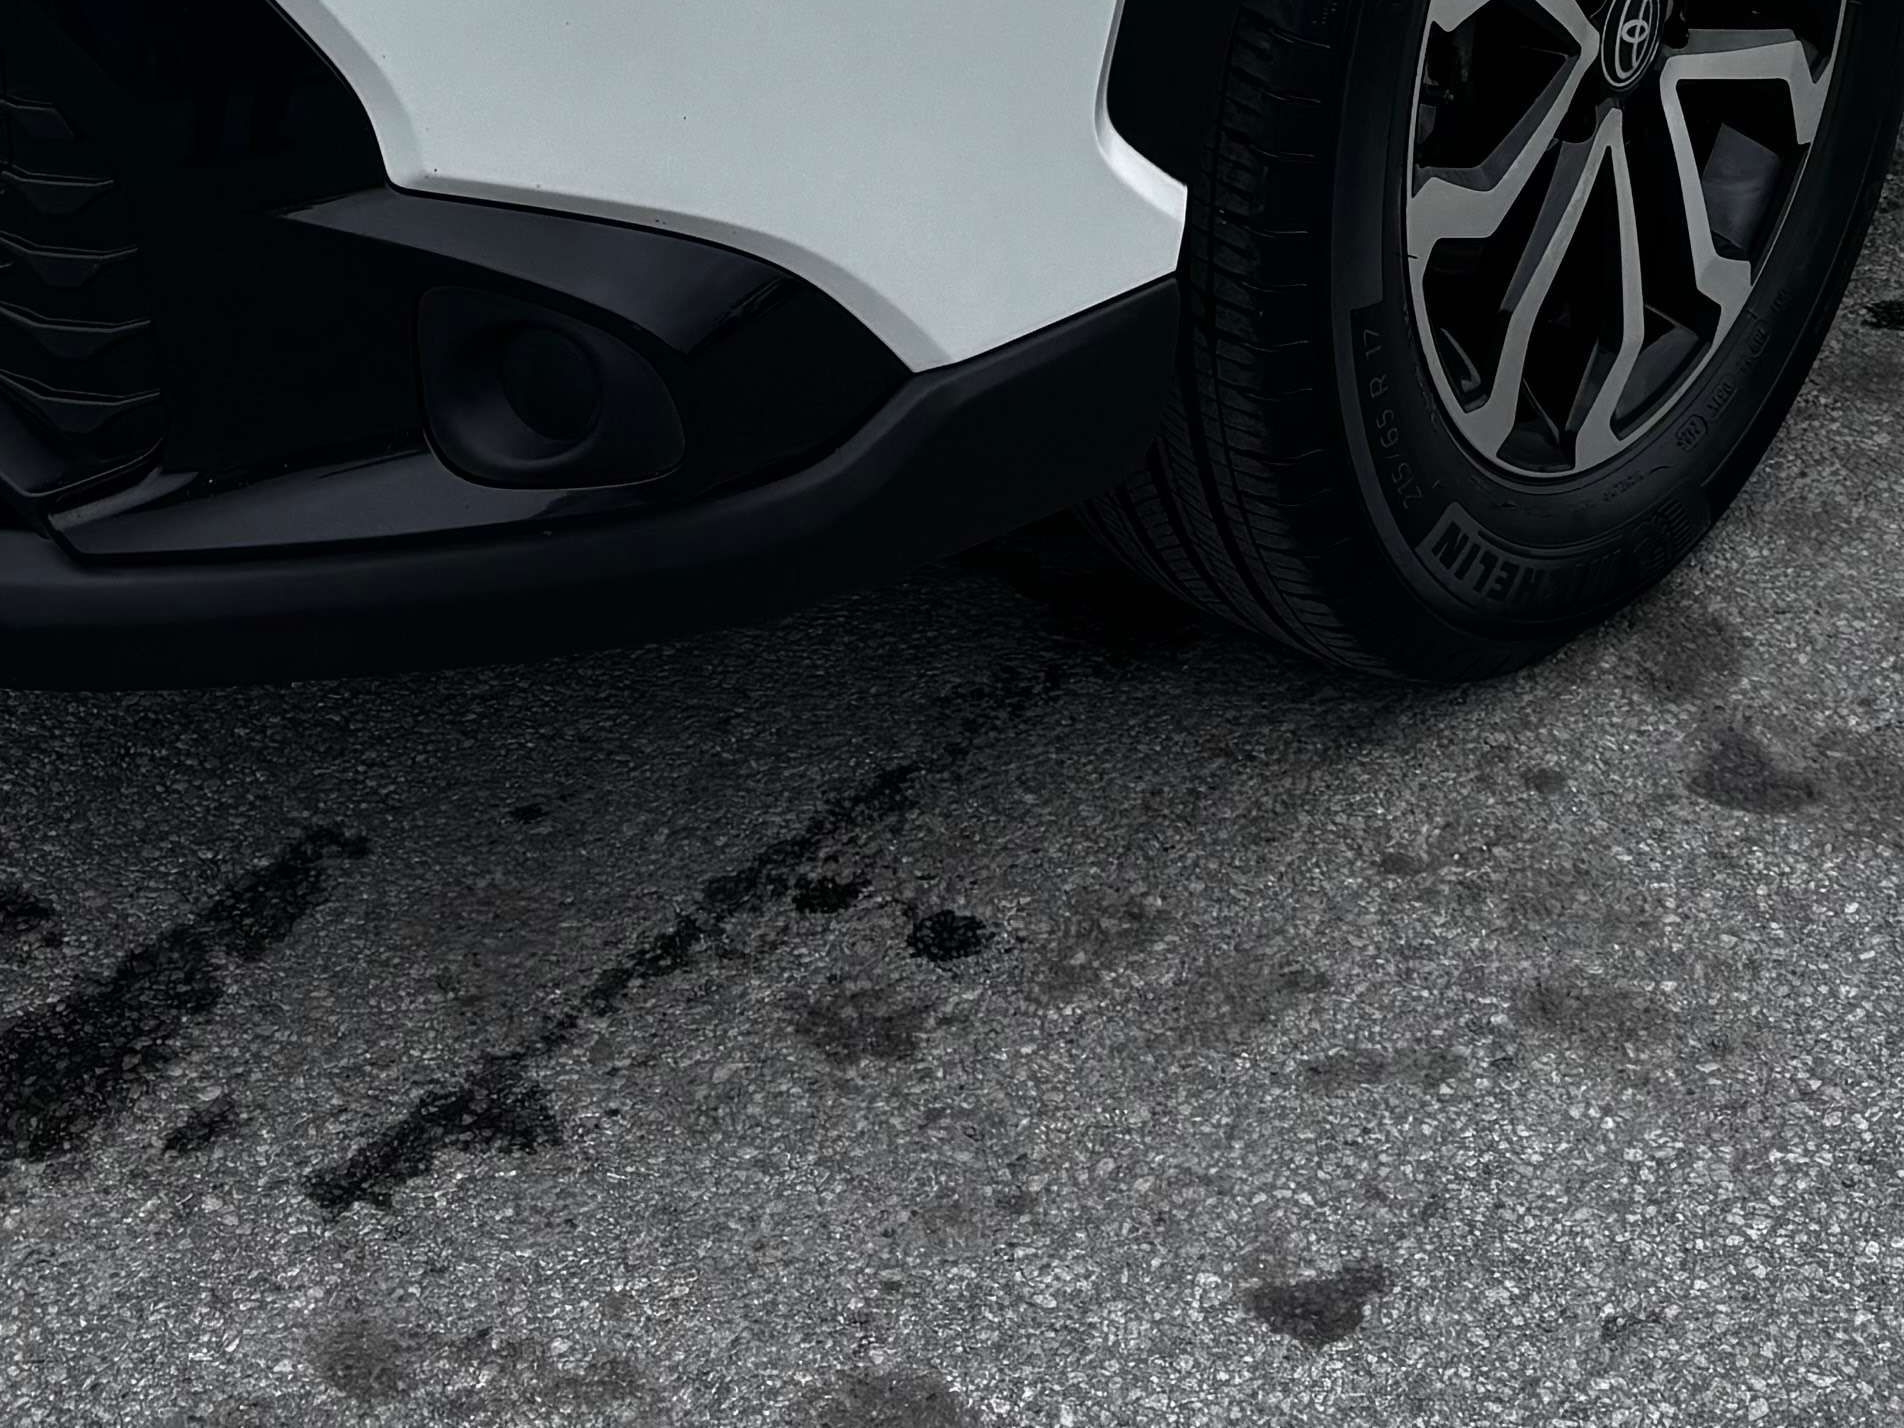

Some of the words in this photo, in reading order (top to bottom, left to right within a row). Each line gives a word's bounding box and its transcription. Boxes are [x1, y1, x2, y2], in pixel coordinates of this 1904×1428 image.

[1362, 328, 1383, 360] 17
[1369, 374, 1389, 399] R
[1376, 409, 1423, 510] 215/65
